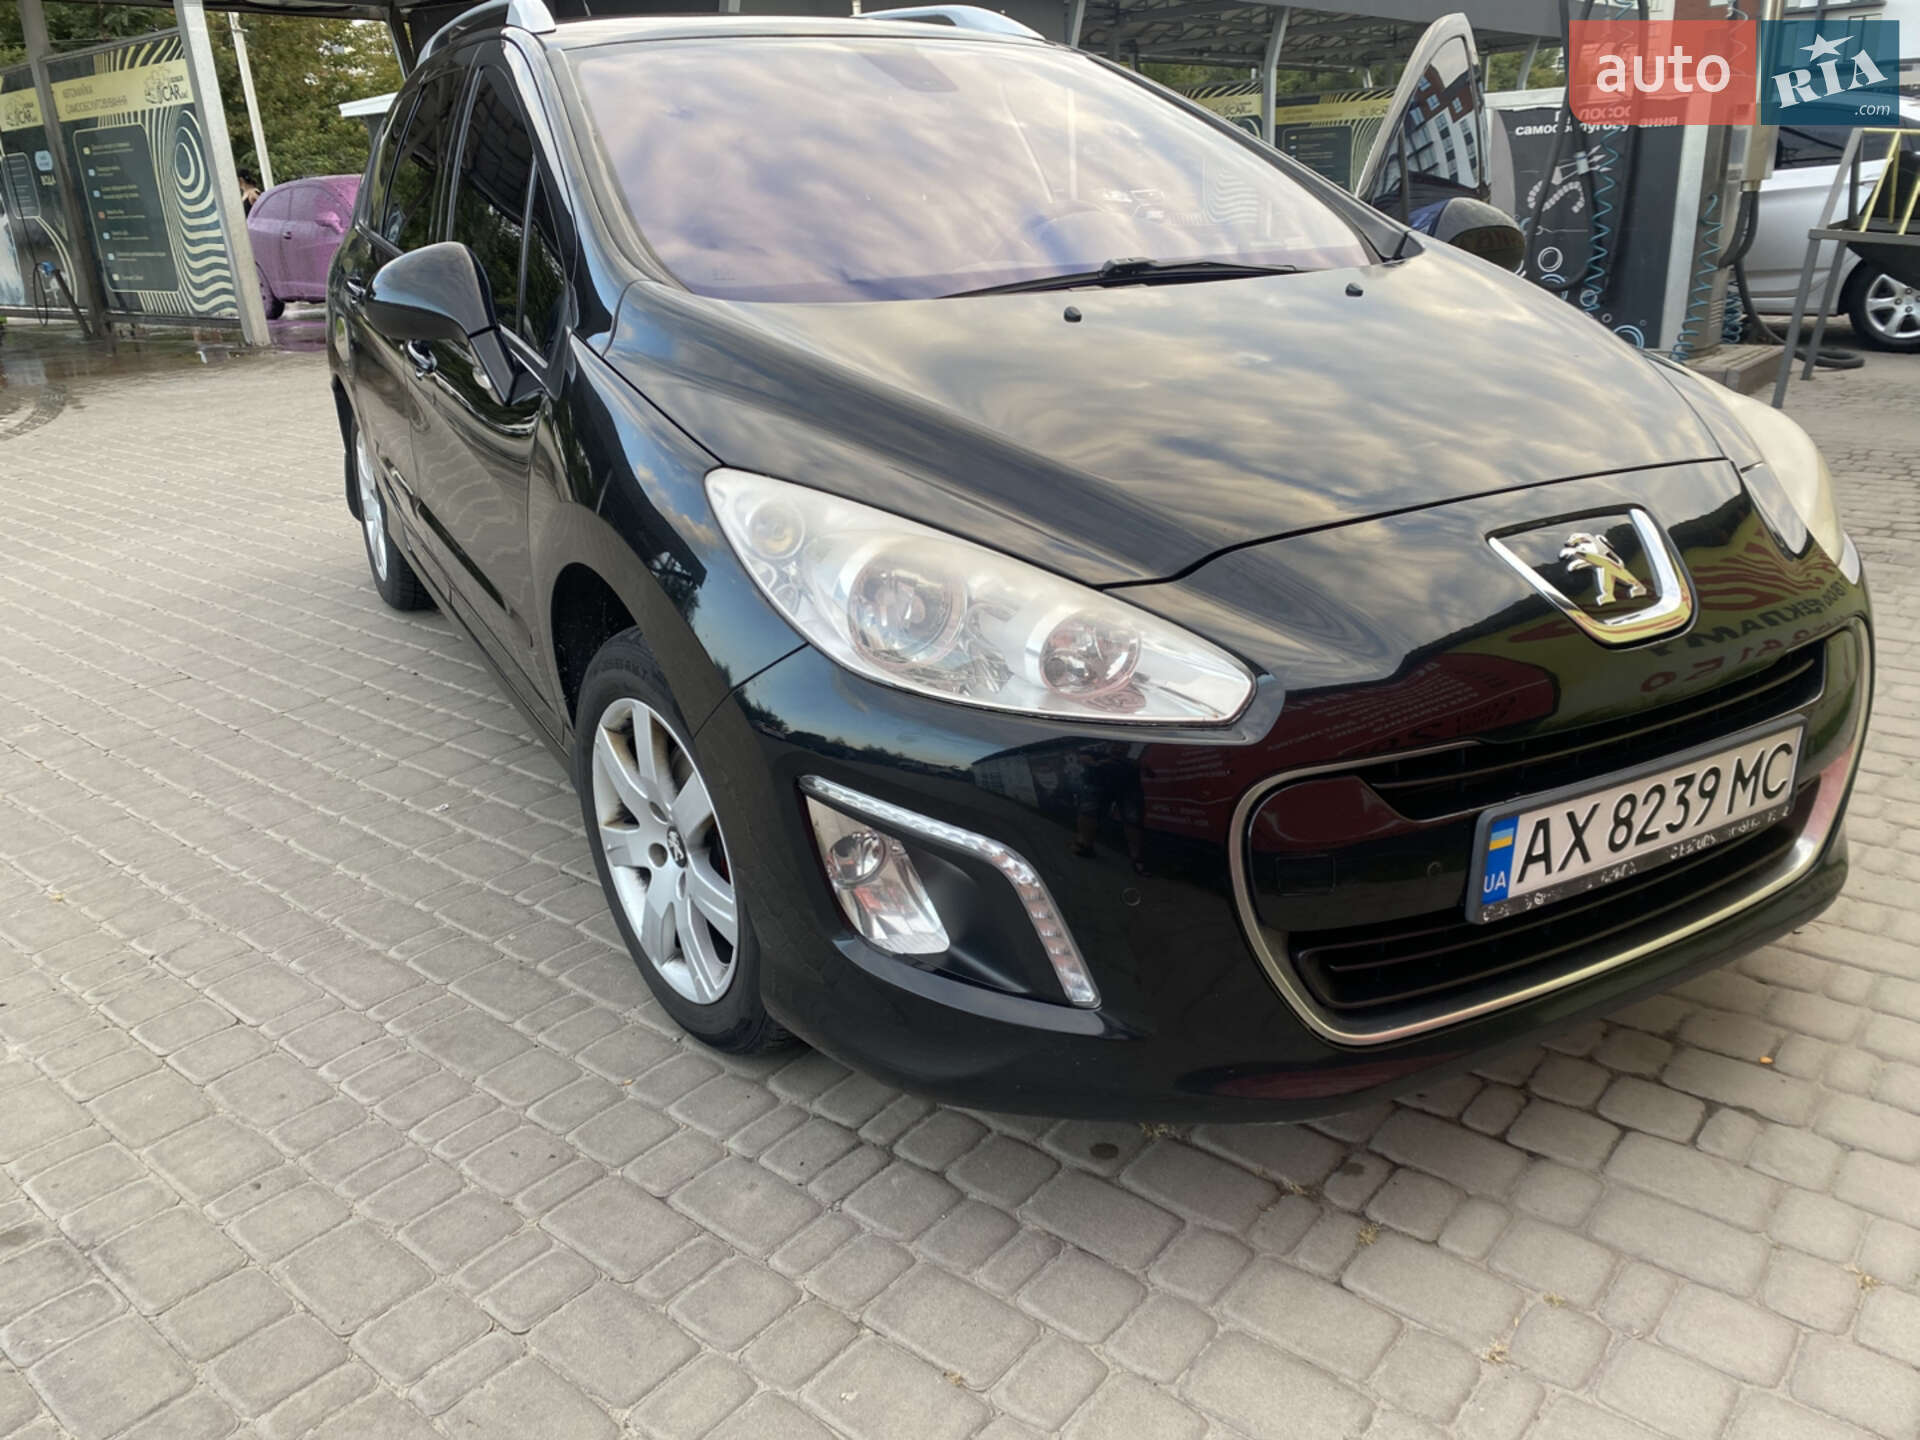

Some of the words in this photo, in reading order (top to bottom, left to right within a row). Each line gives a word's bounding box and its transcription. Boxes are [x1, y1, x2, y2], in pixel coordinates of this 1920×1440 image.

[1516, 803, 1600, 884] AX
[1607, 766, 1721, 853] 8239
[1727, 743, 1793, 816] MC
[1483, 870, 1507, 894] UA
